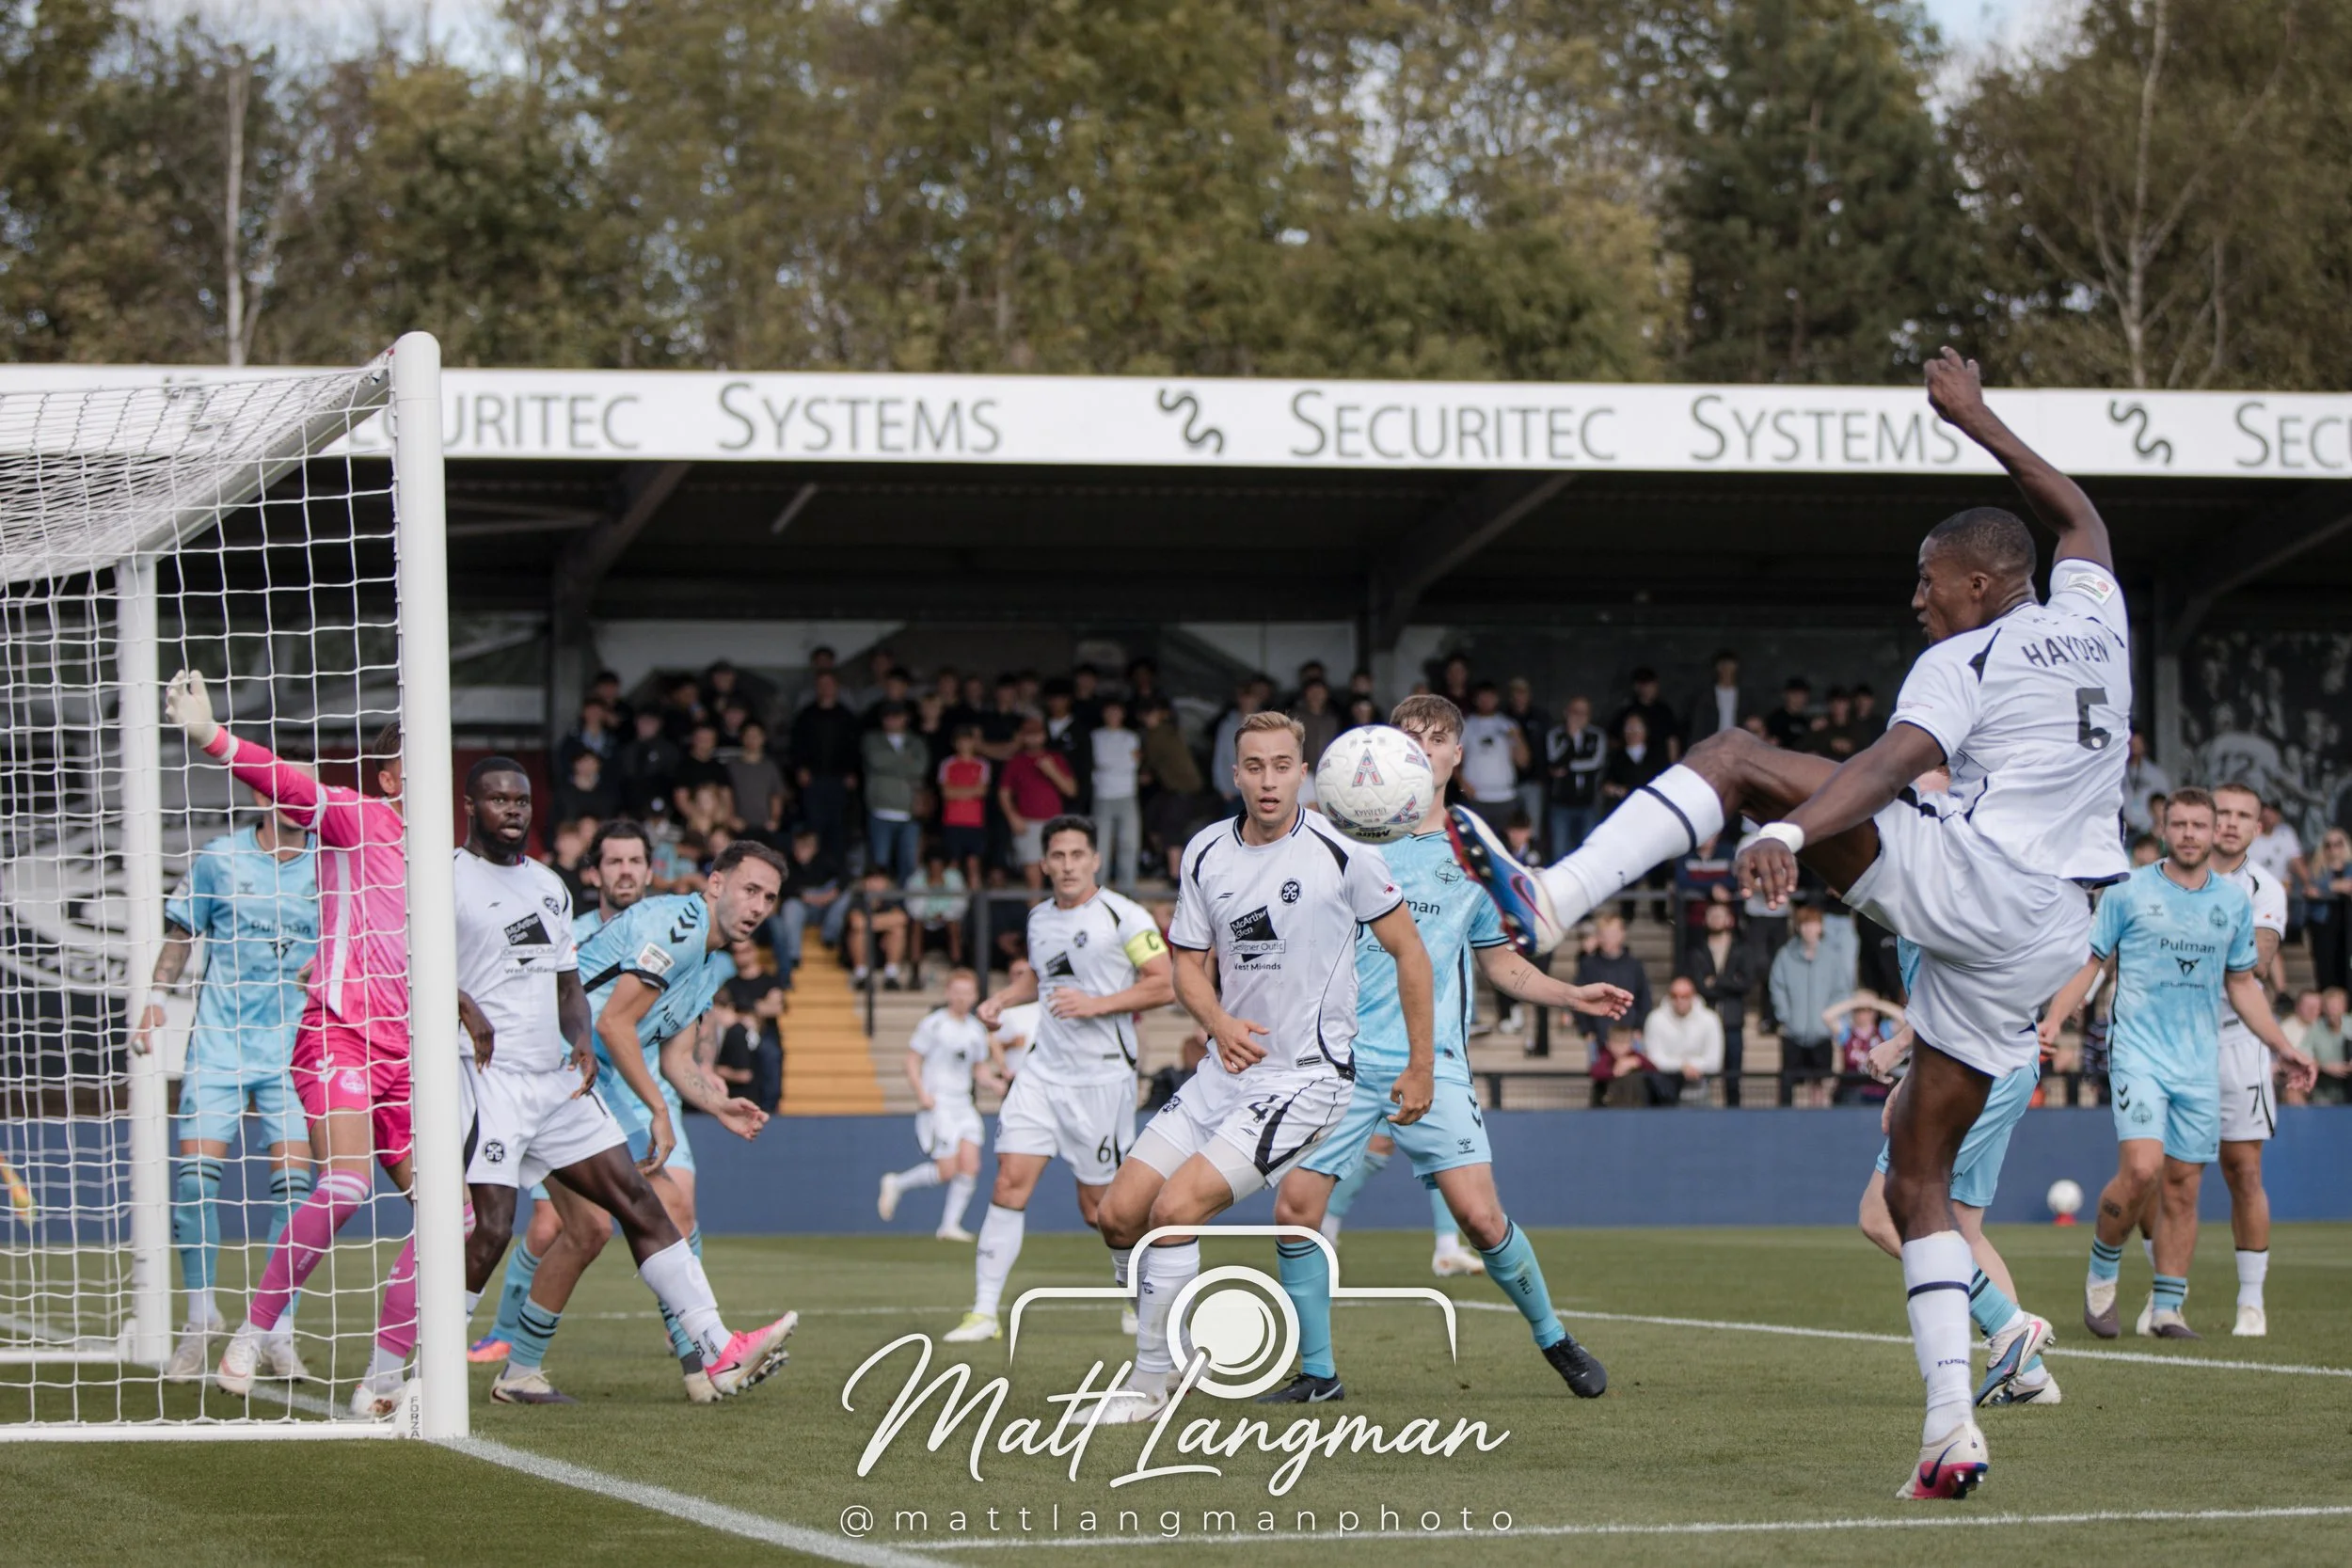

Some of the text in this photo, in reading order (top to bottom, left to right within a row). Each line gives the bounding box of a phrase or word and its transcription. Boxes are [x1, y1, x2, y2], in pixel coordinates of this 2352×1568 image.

[718, 382, 1001, 453] SYSTEMS
[1290, 388, 1960, 464] SECURITEC SYSTEMS
[2235, 401, 2352, 469] SEC
[2021, 636, 2110, 668] HAYDEN
[2075, 687, 2111, 752] 5
[1232, 909, 1267, 931] McArthur
[1235, 927, 1253, 940] Glen
[1146, 930, 1159, 951] C
[2160, 938, 2217, 954] Pulman
[1248, 1094, 1280, 1123] 4
[2247, 1085, 2260, 1117] 7
[1098, 1134, 1111, 1164] 6
[410, 1396, 421, 1439] FORZA
